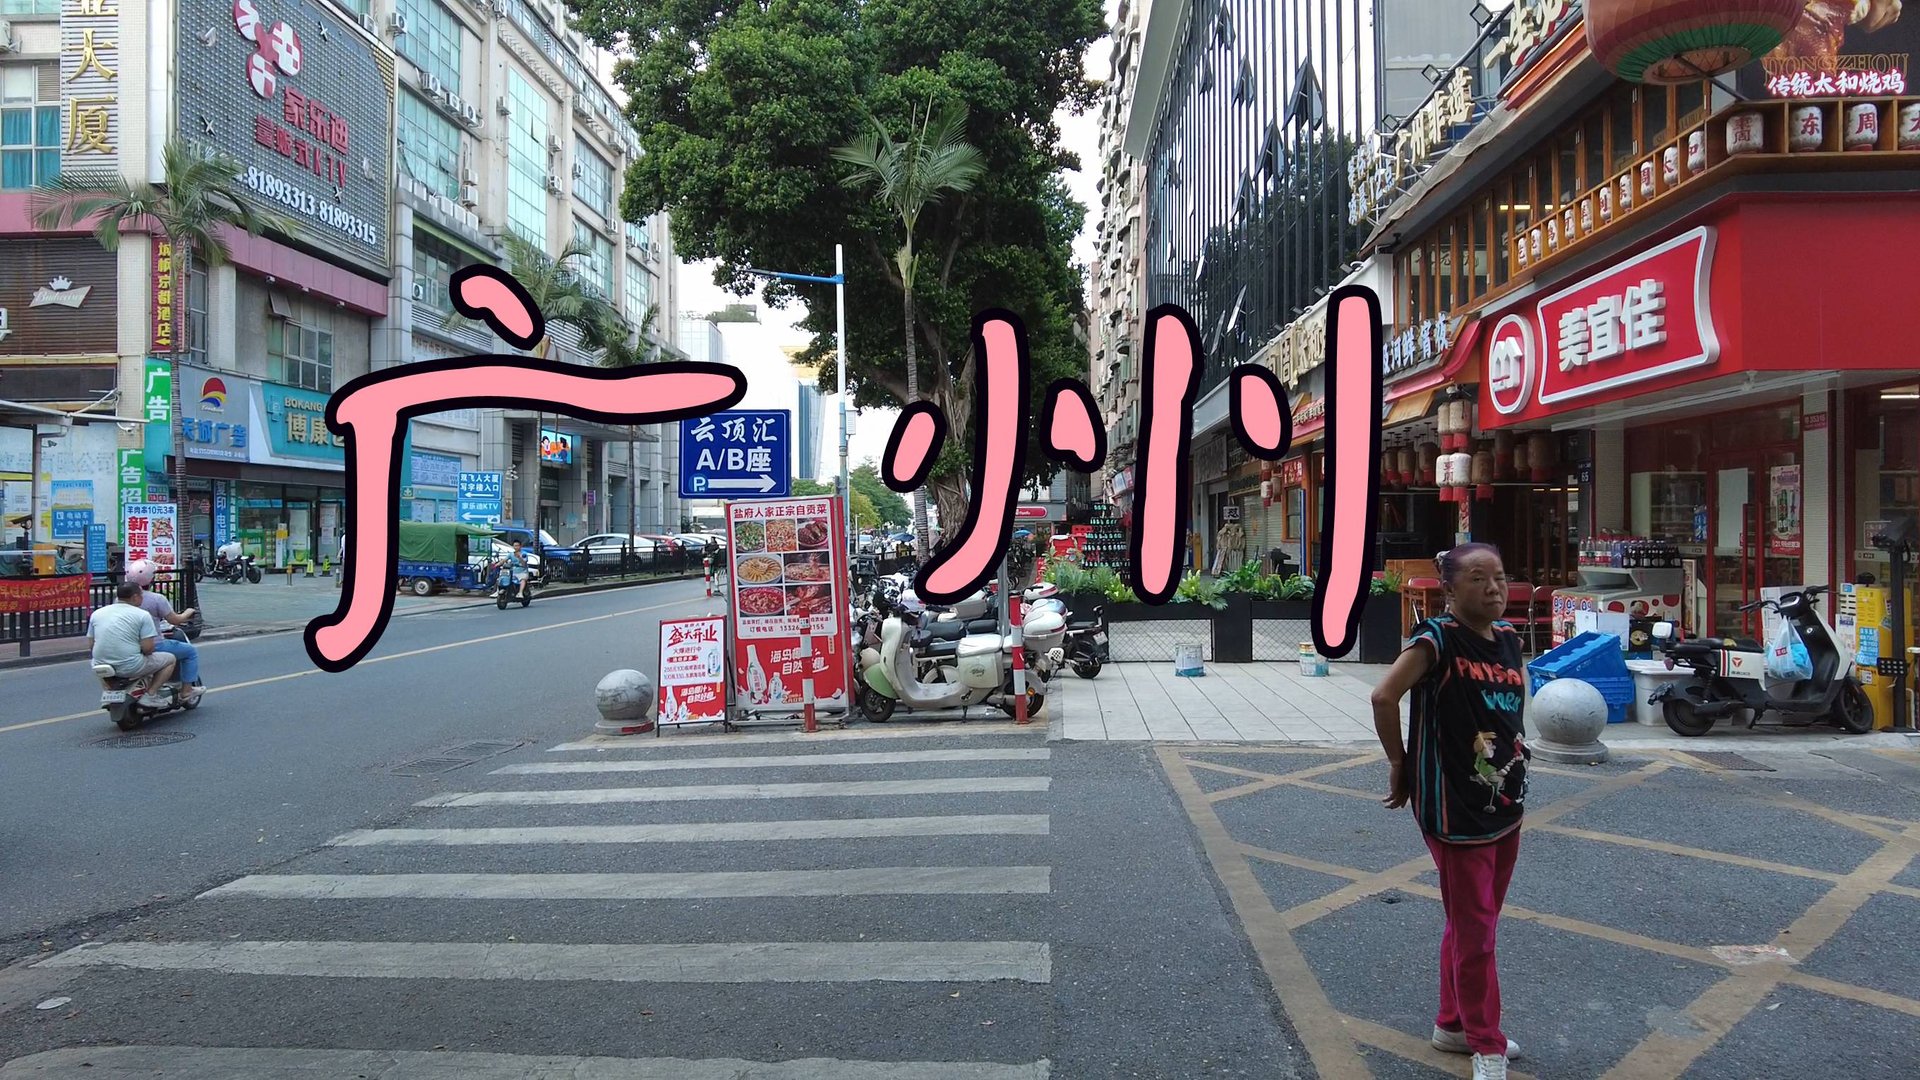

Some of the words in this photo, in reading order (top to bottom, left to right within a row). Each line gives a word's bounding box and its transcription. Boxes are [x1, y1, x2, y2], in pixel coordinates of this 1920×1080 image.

[1768, 69, 1905, 96] 传统太和烧鸡
[284, 85, 349, 155] 家乐迪
[1801, 113, 1820, 136] 东
[1855, 112, 1876, 134] 周
[319, 201, 377, 245] 81893315
[1558, 279, 1667, 372] 美宜佳
[146, 367, 170, 421] 广告
[284, 396, 322, 412] BOKANG
[691, 417, 778, 443] 云顶汇
[696, 446, 772, 472] A/B座
[460, 473, 499, 483] 双飞人大厦
[460, 483, 499, 492] 写字楼入口
[734, 503, 827, 519] 盐府人家正宗自贡菜
[667, 624, 719, 648] 盛大开业
